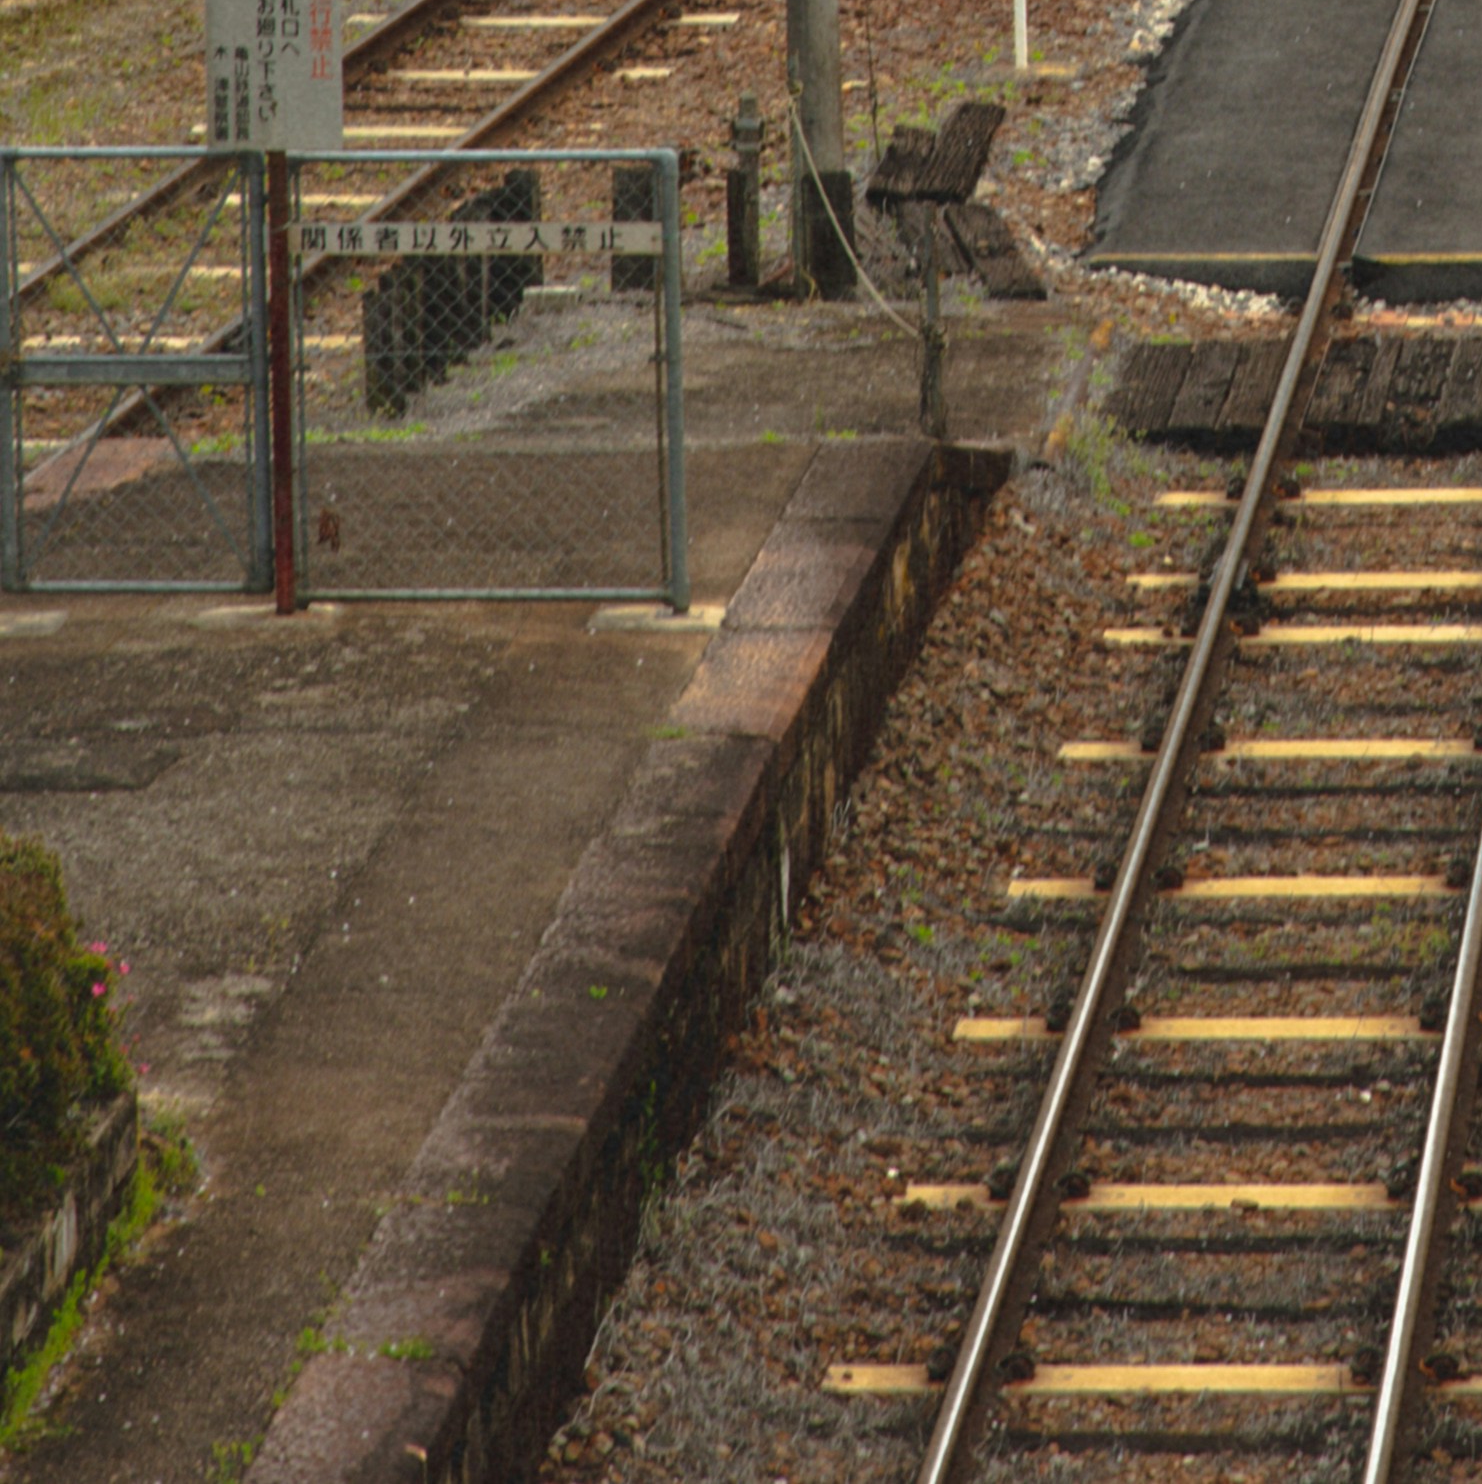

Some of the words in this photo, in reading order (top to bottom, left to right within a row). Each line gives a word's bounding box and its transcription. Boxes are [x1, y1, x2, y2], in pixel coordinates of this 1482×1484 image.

[300, 225, 625, 252] 関係者以外立入禁止
